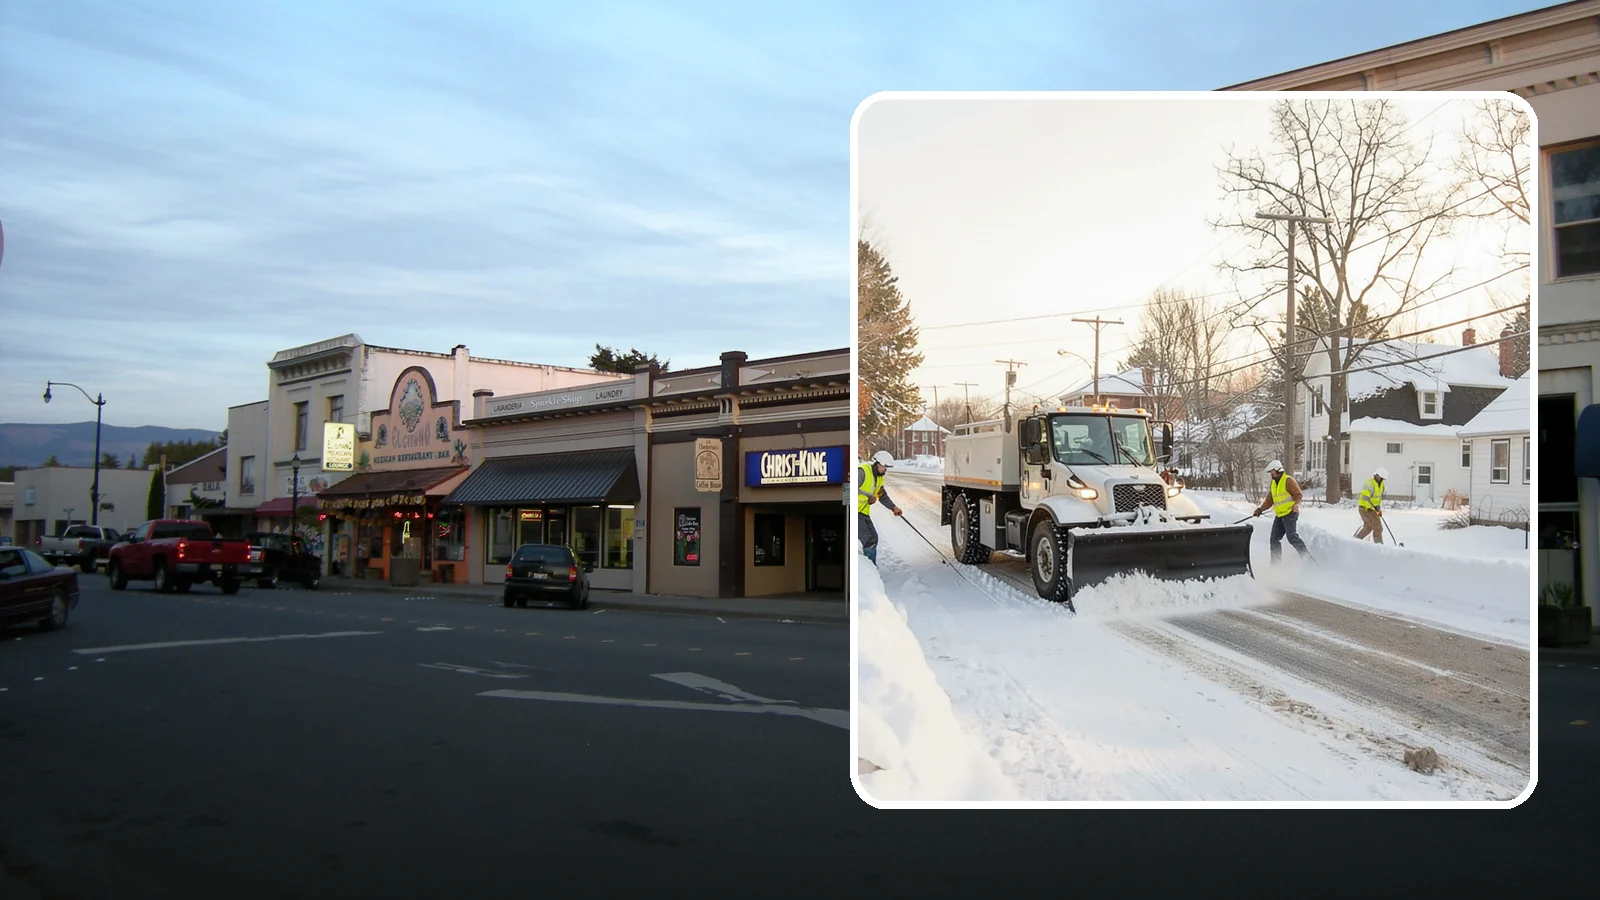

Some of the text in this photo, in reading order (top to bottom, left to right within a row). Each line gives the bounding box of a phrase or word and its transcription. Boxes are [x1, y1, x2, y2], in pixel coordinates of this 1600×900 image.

[530, 393, 582, 408] Sparkle Shop
[595, 389, 623, 400] LAUNDRY
[493, 402, 522, 412] LAVANDERIA
[373, 455, 396, 464] MEXICAN
[397, 451, 433, 462] RESTAURANT
[438, 450, 450, 459] BAR
